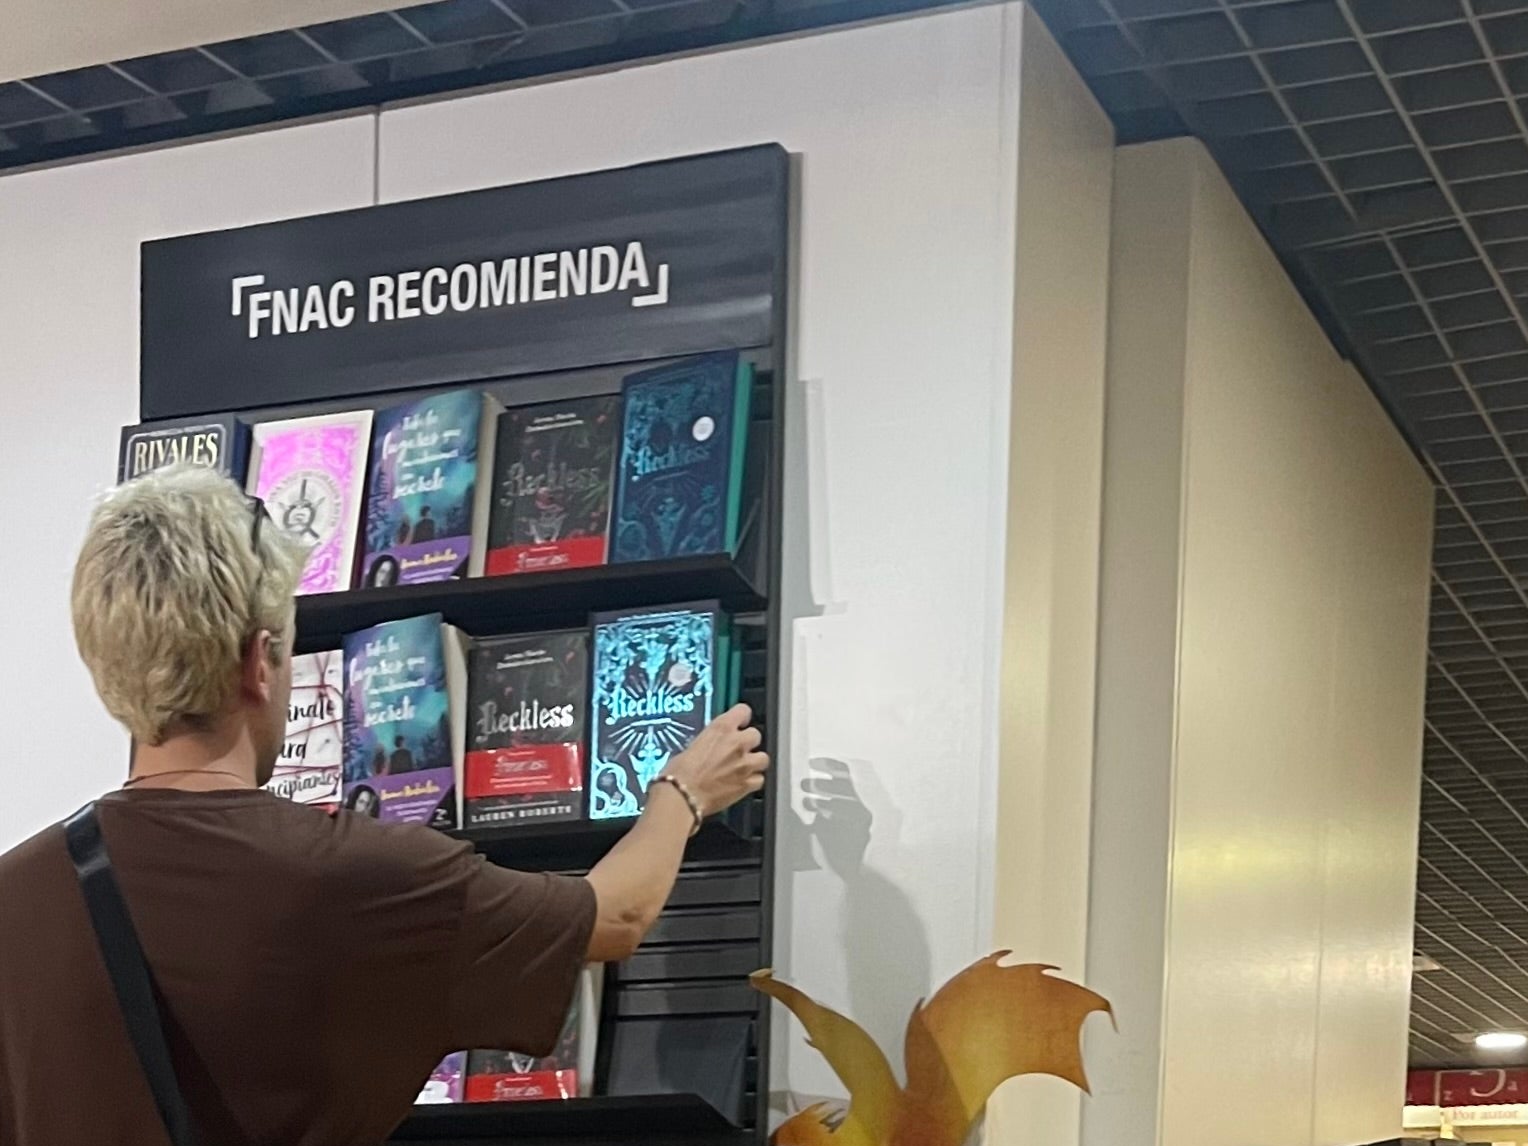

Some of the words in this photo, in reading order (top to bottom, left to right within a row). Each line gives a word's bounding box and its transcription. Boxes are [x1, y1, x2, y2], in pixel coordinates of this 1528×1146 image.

[248, 280, 354, 338] FNAC
[368, 241, 649, 322] RECOMIENDA
[132, 432, 220, 476] RIVALES
[475, 699, 574, 742] Reckless
[603, 690, 694, 726] Reckless
[519, 805, 572, 819] ROBERTS
